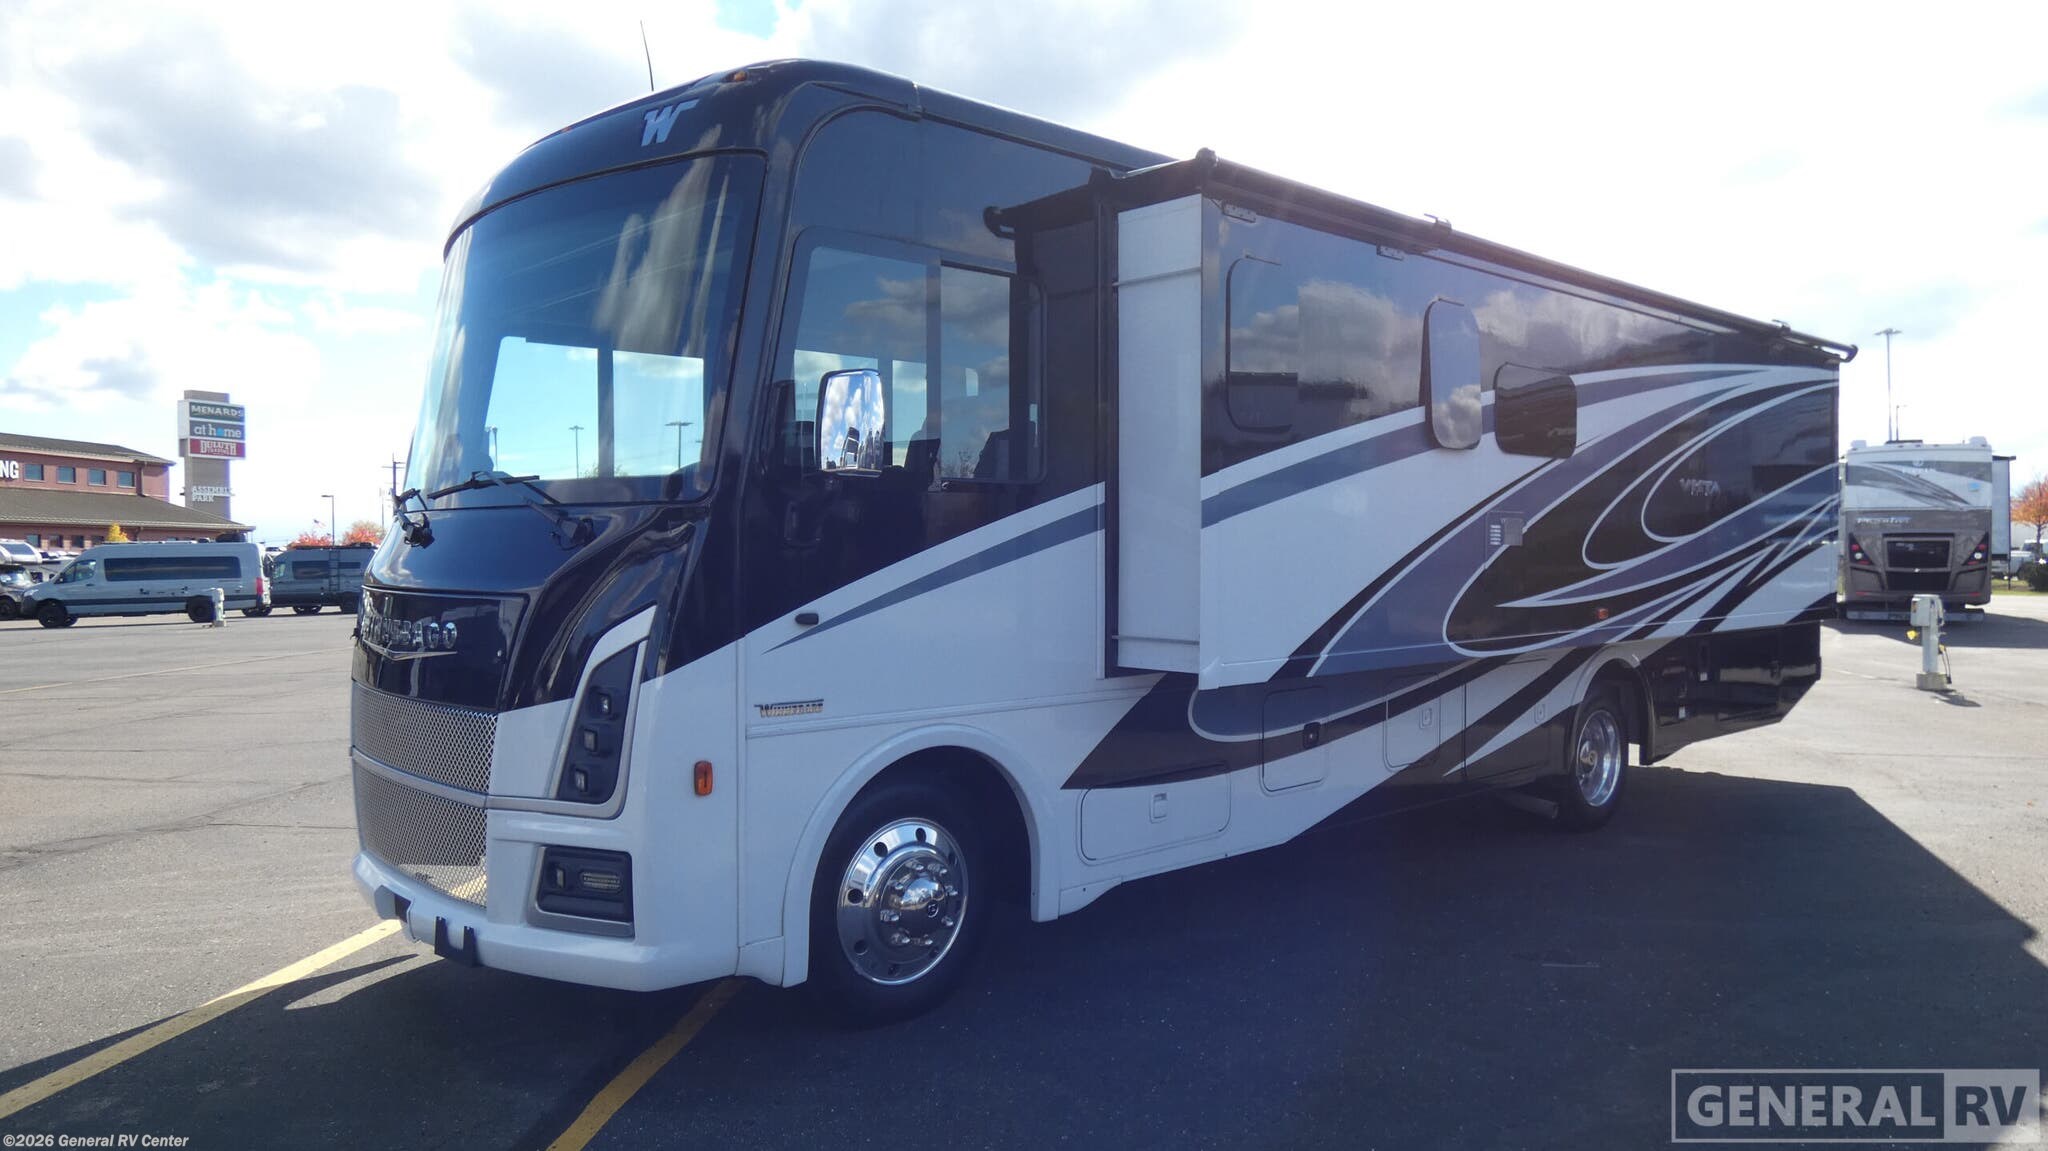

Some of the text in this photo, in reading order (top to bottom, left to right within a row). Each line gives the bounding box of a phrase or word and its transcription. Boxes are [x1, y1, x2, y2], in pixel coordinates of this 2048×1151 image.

[191, 405, 244, 416] MENARDS
[194, 425, 206, 435] at
[200, 440, 236, 456] DULUTH
